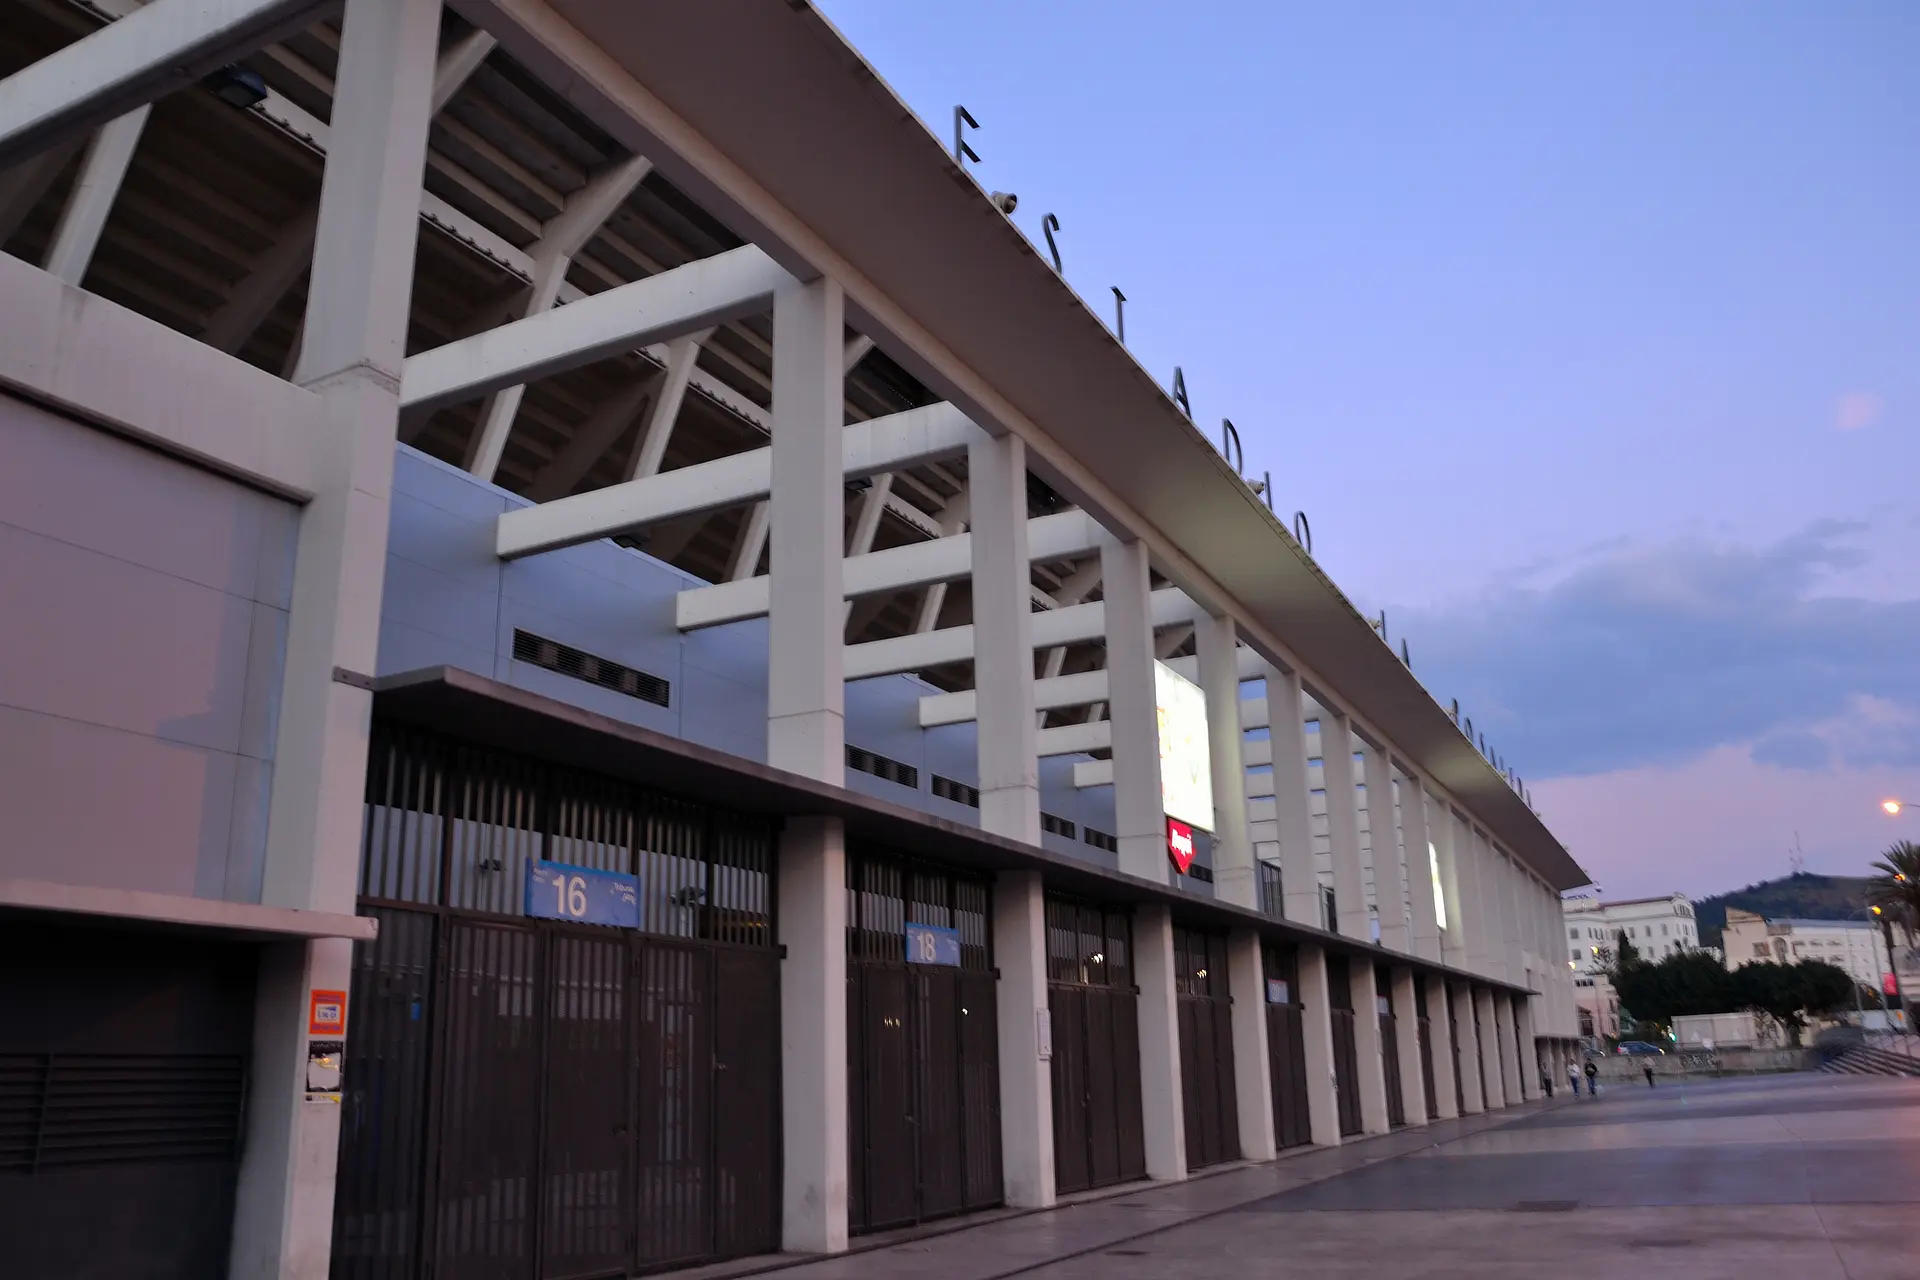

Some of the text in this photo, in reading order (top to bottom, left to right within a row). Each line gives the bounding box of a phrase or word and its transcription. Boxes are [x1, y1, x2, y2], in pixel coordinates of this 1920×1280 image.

[953, 104, 1312, 555] ESTADIO
[552, 874, 587, 917] 16
[917, 931, 937, 962] 18
